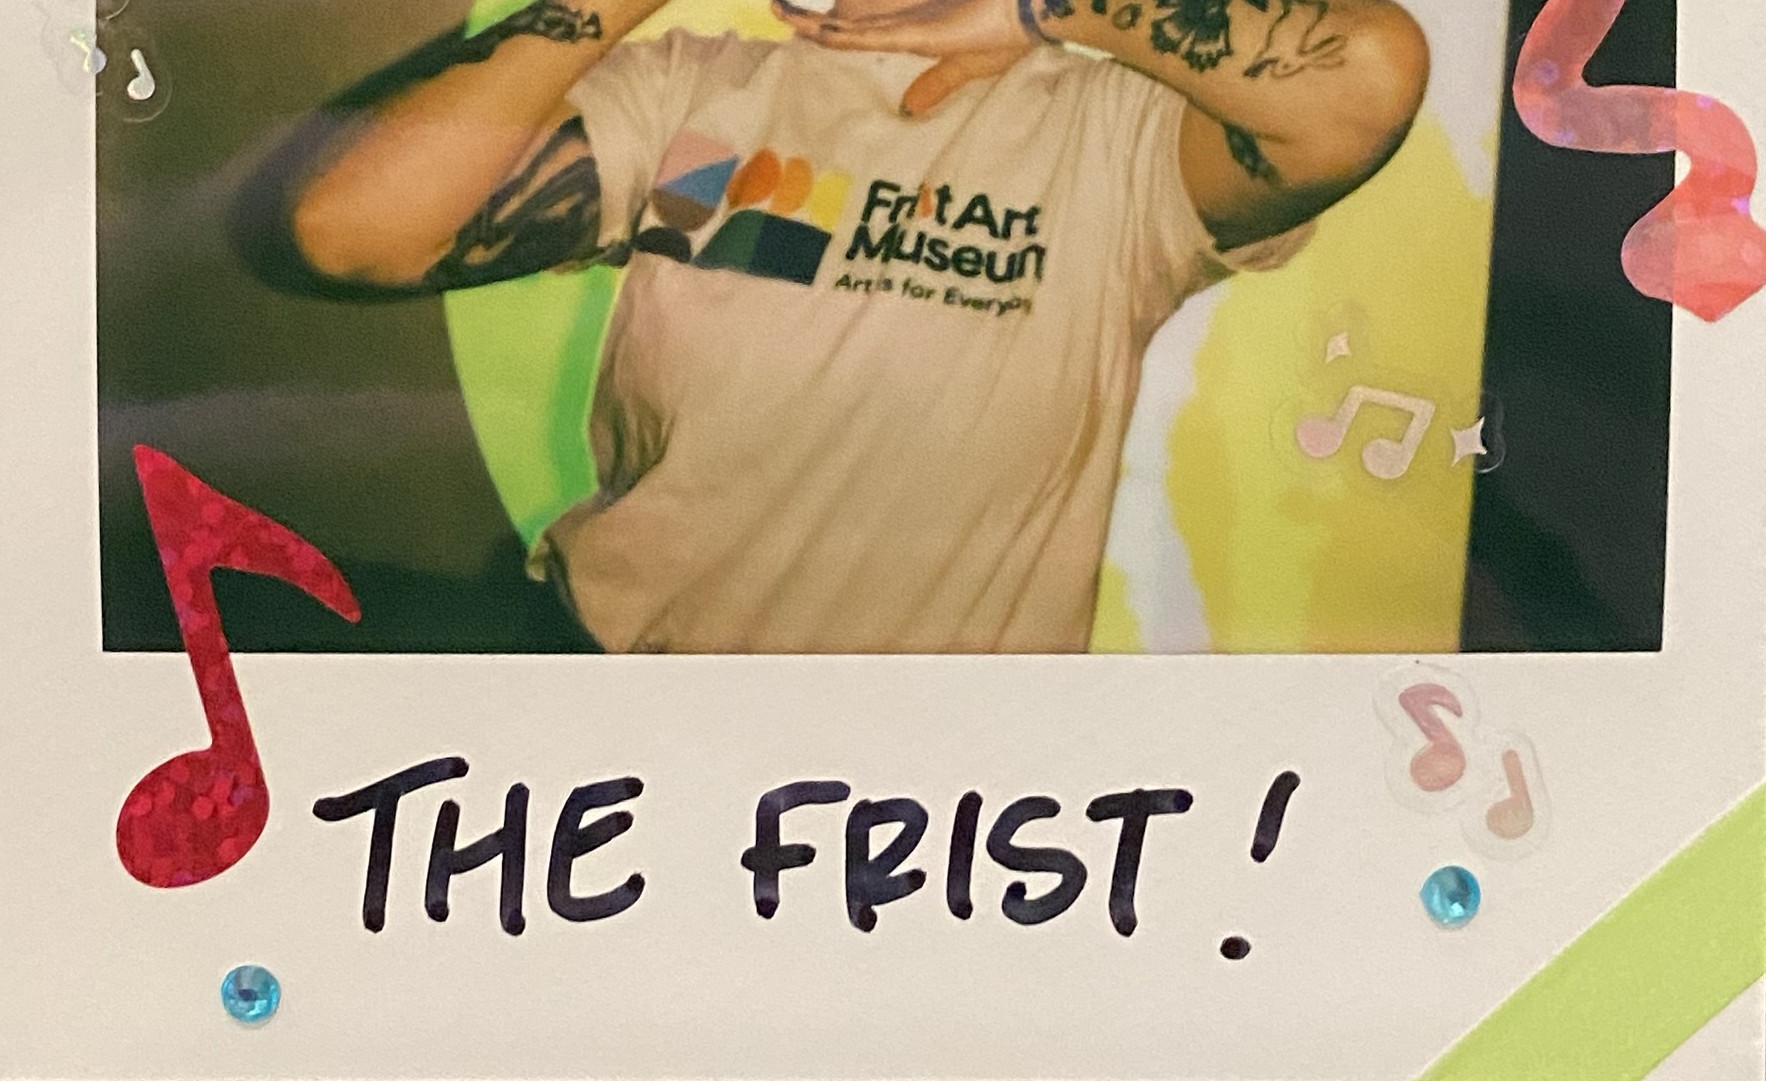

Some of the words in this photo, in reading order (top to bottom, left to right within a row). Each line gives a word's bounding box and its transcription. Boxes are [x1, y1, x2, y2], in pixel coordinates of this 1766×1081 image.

[952, 193, 1042, 241] Art
[901, 276, 937, 300] for
[313, 756, 646, 937] THE
